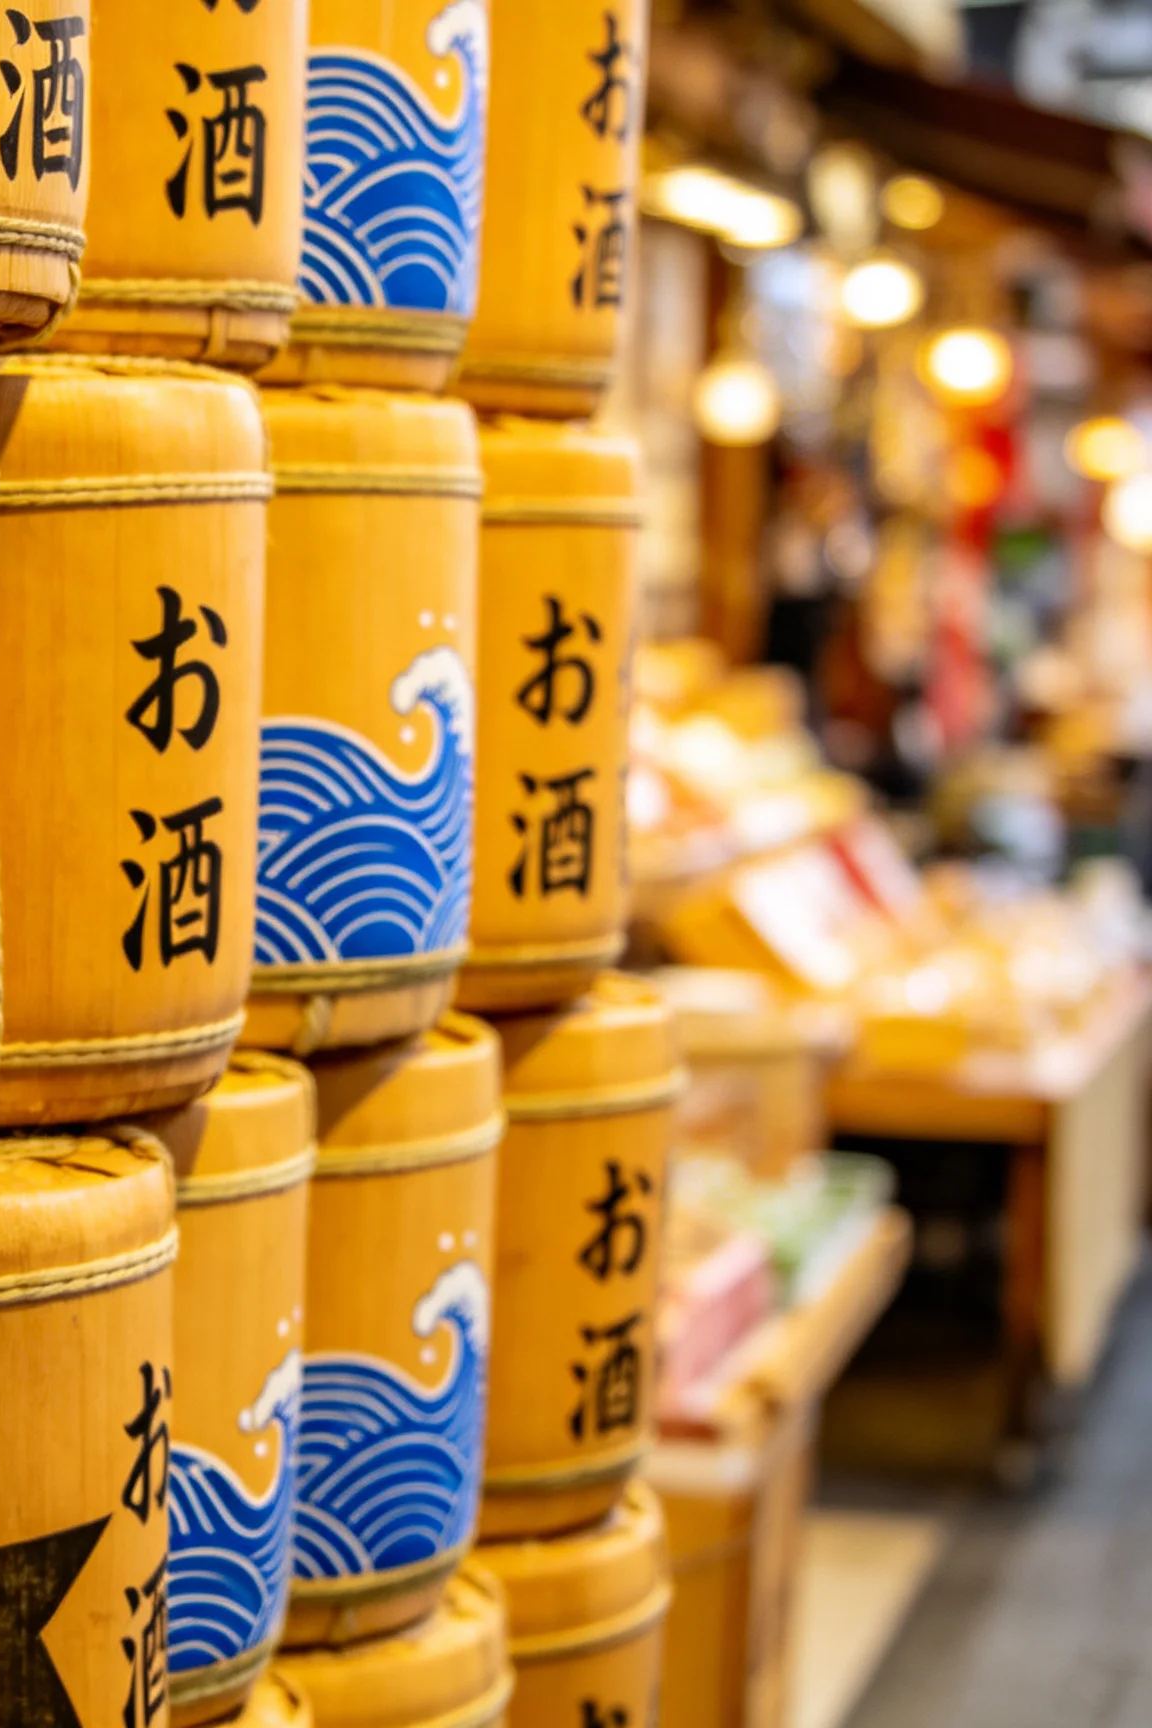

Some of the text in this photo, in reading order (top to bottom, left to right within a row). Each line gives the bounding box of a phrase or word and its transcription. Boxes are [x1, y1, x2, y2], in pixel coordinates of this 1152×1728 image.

[571, 8, 630, 312] お酒
[119, 584, 229, 973] お酒
[508, 591, 604, 902] お酒
[567, 1158, 653, 1442] お酒
